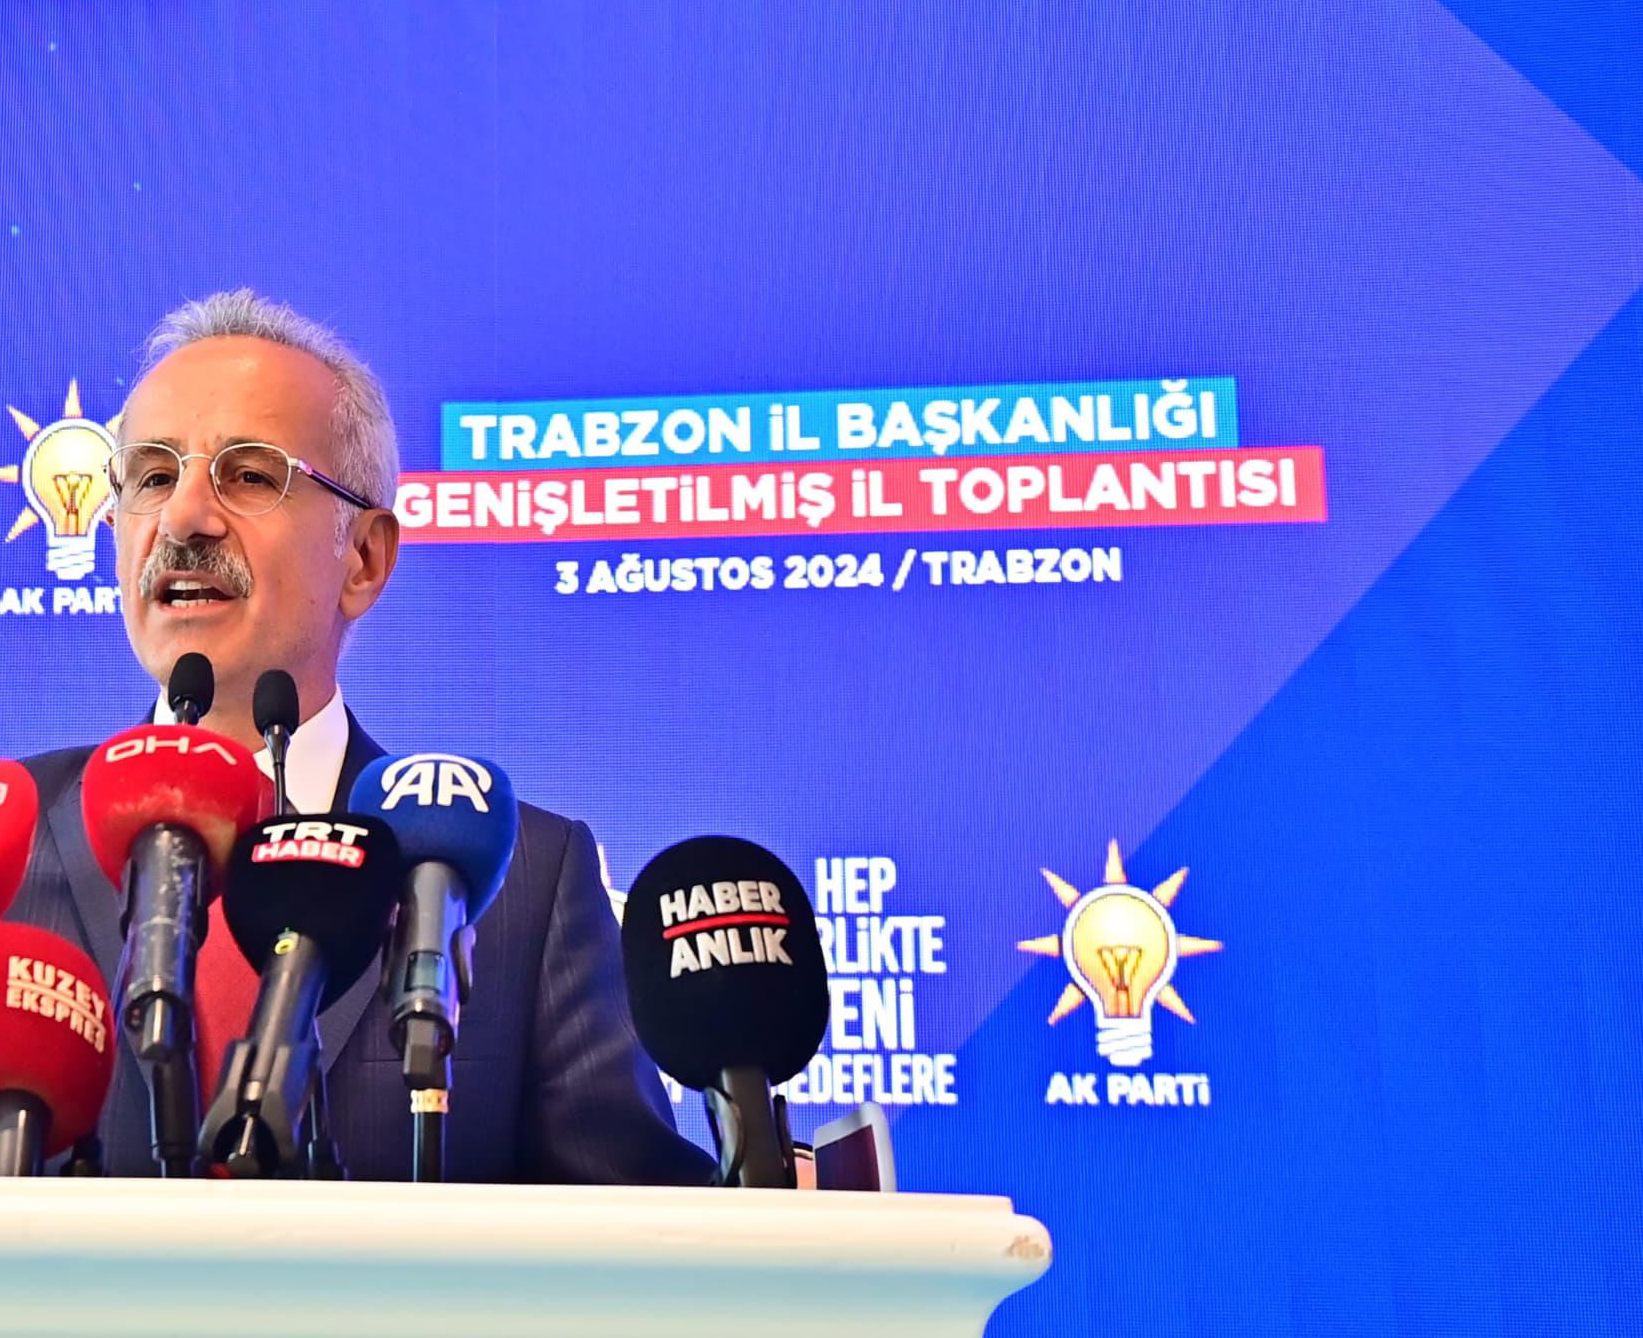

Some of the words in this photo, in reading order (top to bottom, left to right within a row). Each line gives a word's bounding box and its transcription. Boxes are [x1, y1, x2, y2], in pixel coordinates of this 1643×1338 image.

[461, 408, 753, 461] TRABZON
[838, 380, 1217, 457] BAŞKANLIĞI
[928, 458, 1297, 516] TOPLANTISI
[555, 562, 580, 595] 3
[586, 554, 775, 596] AĞUSTOS
[784, 554, 885, 590] 2024
[892, 551, 914, 593] /
[922, 548, 1122, 586] TRABZON
[52, 586, 123, 615] PAR
[106, 735, 237, 765] DHA
[381, 754, 491, 813] AA
[255, 840, 361, 866] HABER
[262, 821, 369, 847] TRT
[660, 880, 786, 927] HABER
[816, 857, 897, 915] HEP
[670, 926, 793, 978] ANLIK
[8, 955, 106, 1023] KUZEY
[6, 987, 106, 1053] EKSPRES
[827, 979, 916, 1051] ENi
[770, 1053, 958, 1104] EDEFLERE
[1045, 1075, 1099, 1105] AK
